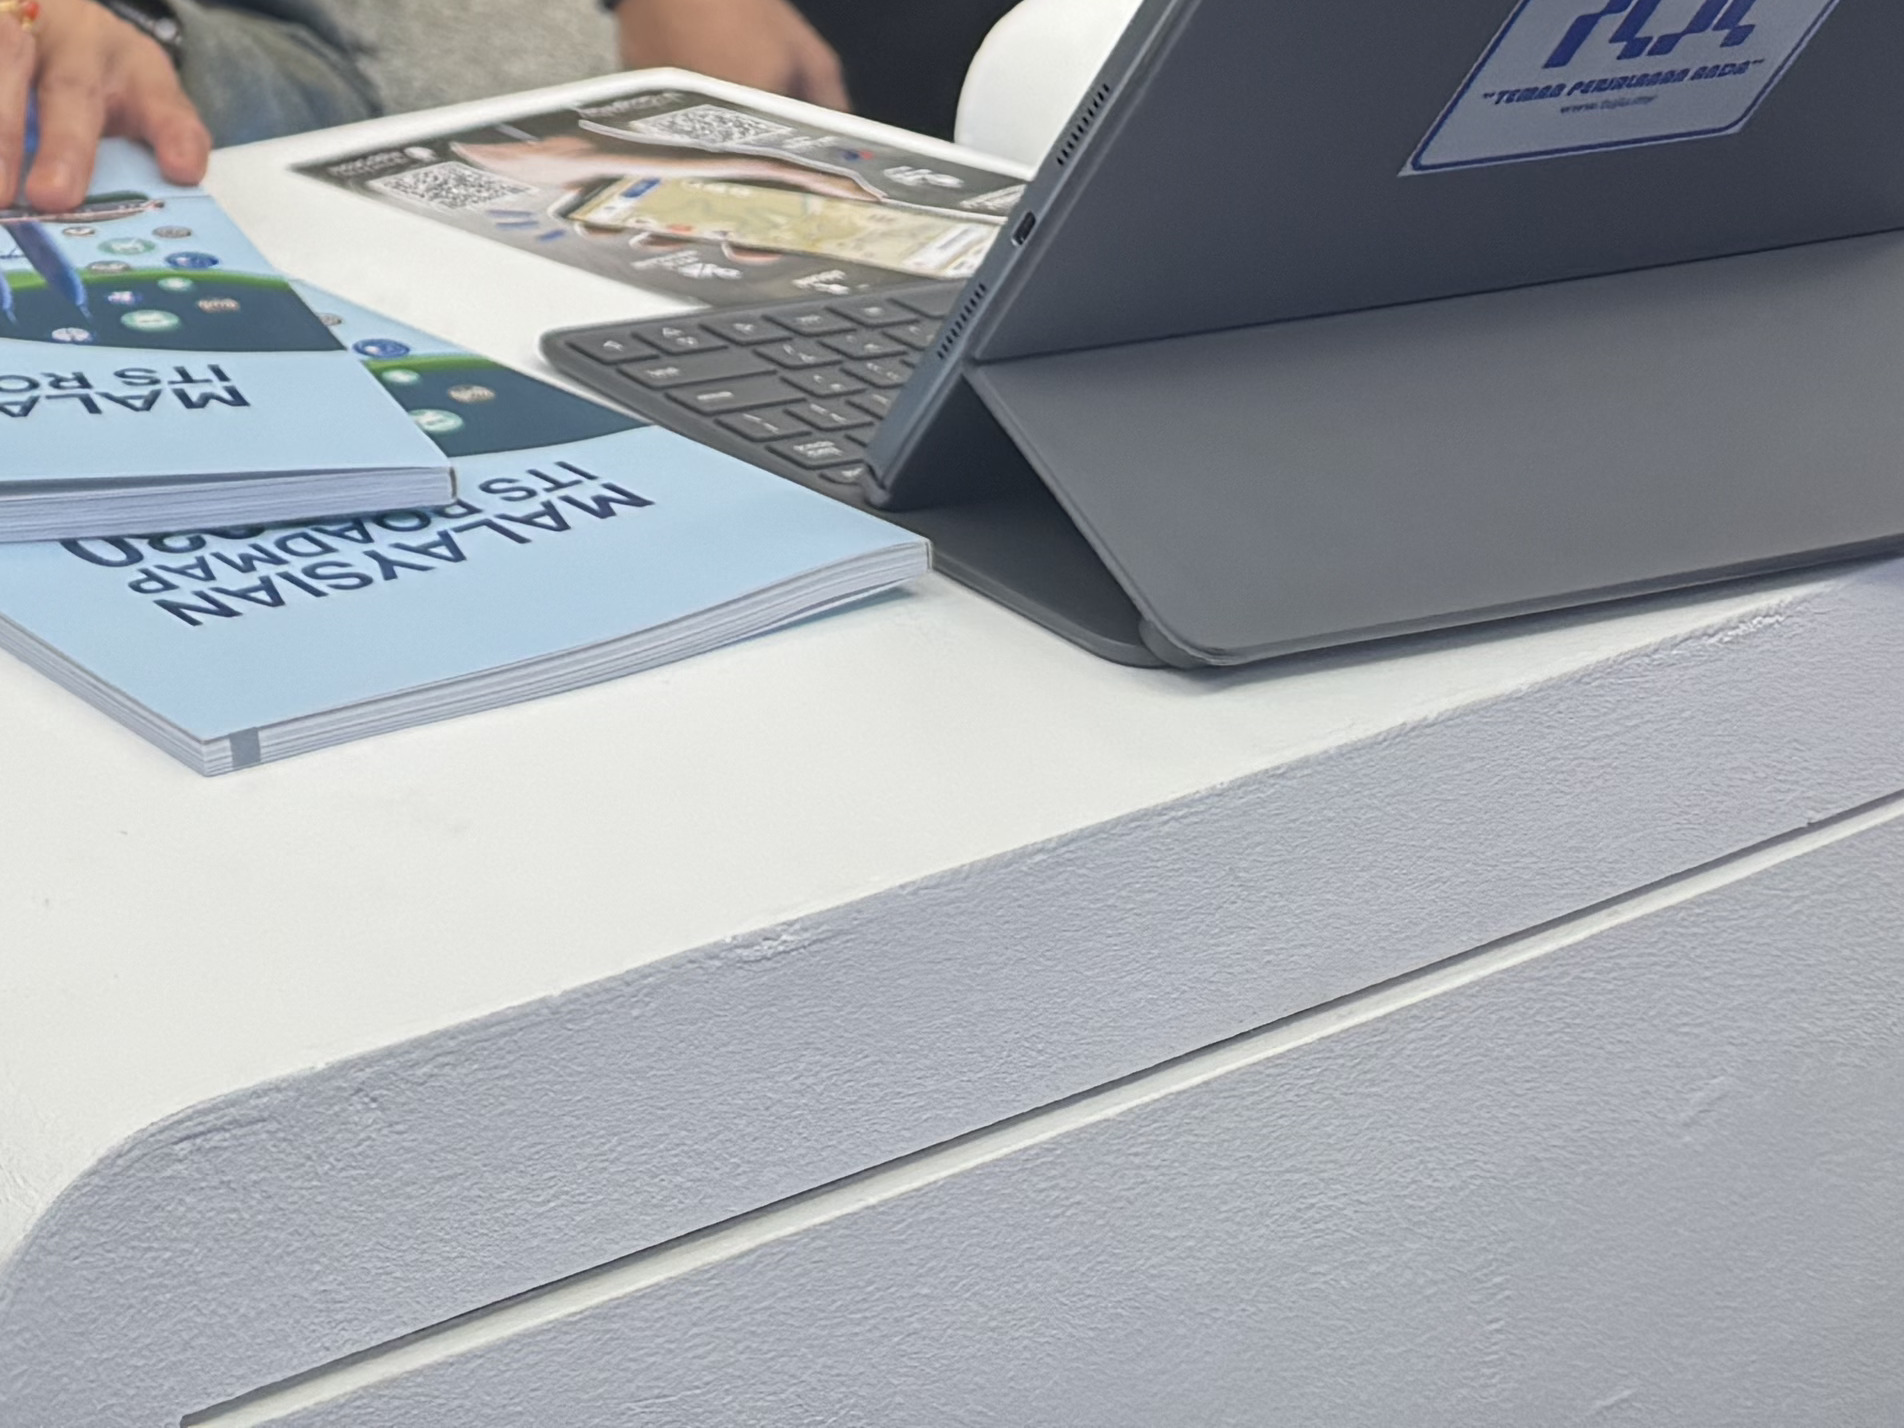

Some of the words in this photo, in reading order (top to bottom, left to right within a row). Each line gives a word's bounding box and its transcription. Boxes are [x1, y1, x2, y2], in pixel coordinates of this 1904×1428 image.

[112, 363, 232, 388] ITS
[478, 460, 600, 503] ITS
[152, 481, 656, 627] MALAYSIAN
